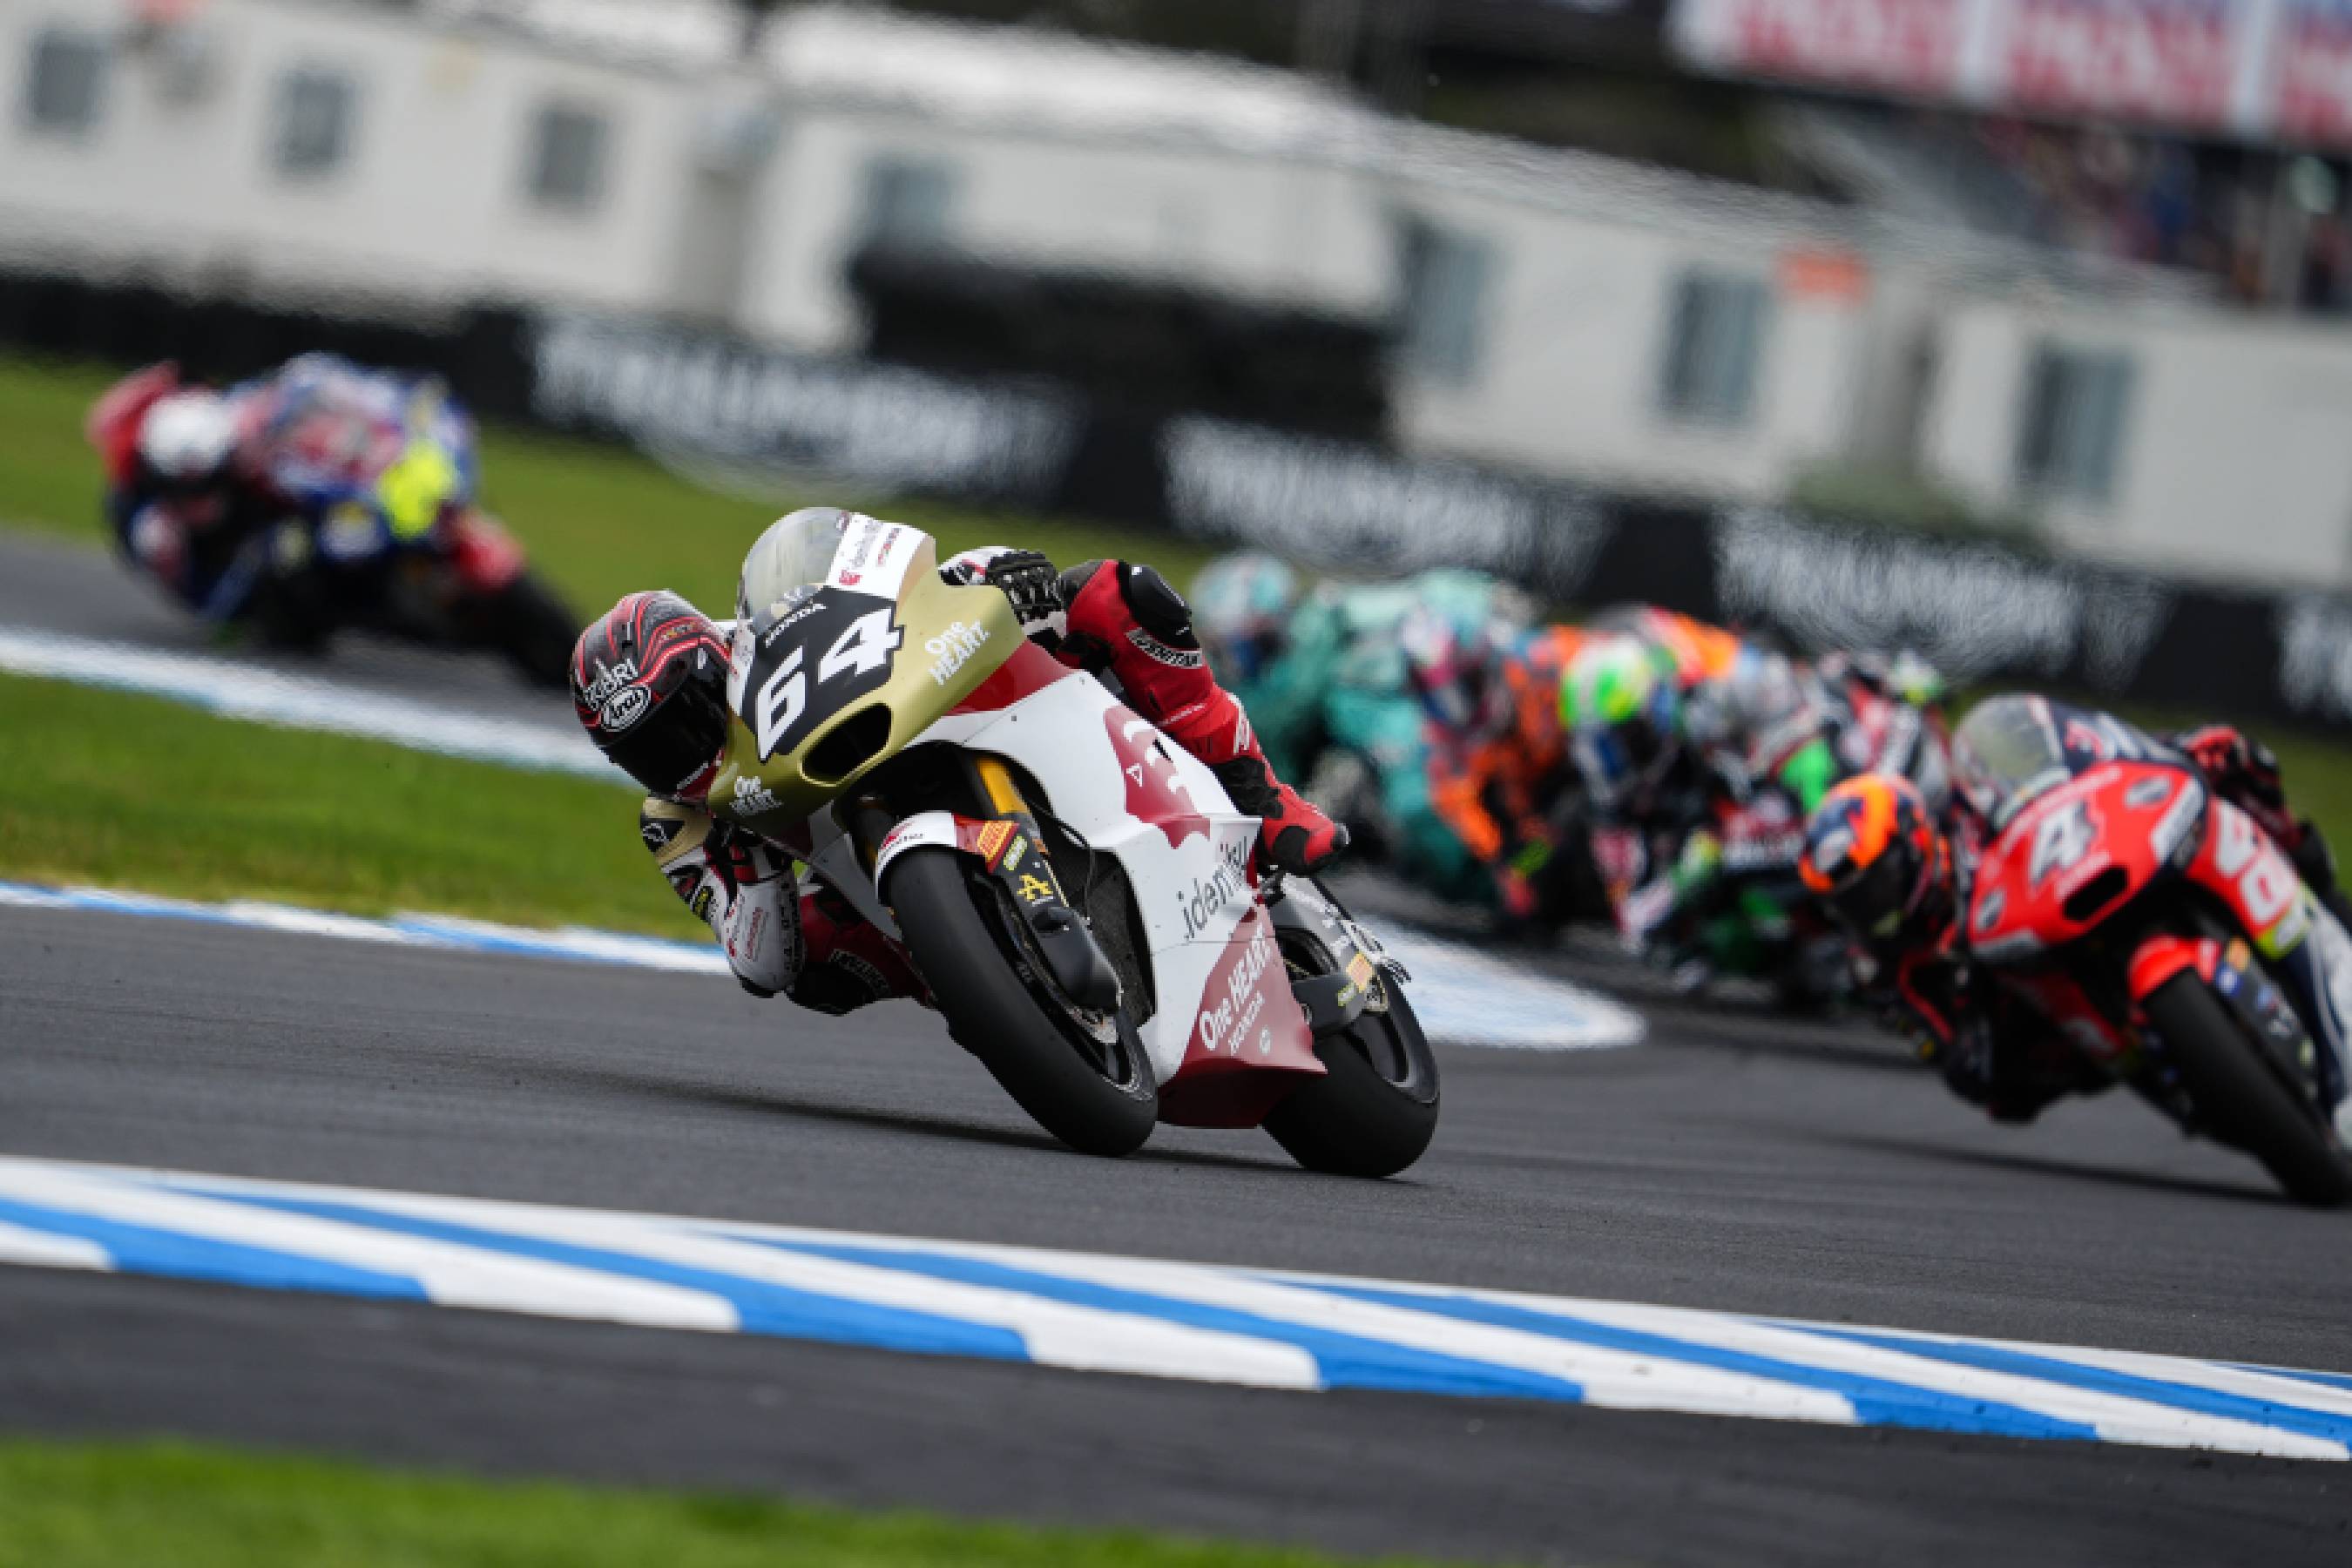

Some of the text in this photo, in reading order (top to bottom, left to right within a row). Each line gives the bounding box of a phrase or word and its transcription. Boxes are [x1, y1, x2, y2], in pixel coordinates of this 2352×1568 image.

[766, 602, 826, 647] HONDA
[924, 619, 966, 657] One
[604, 691, 643, 729] Arai
[756, 609, 901, 762] 64
[733, 774, 762, 800] One
[2031, 801, 2095, 883] 4
[1199, 922, 1273, 1051] One HEART
[1227, 990, 1266, 1056] HONDA
